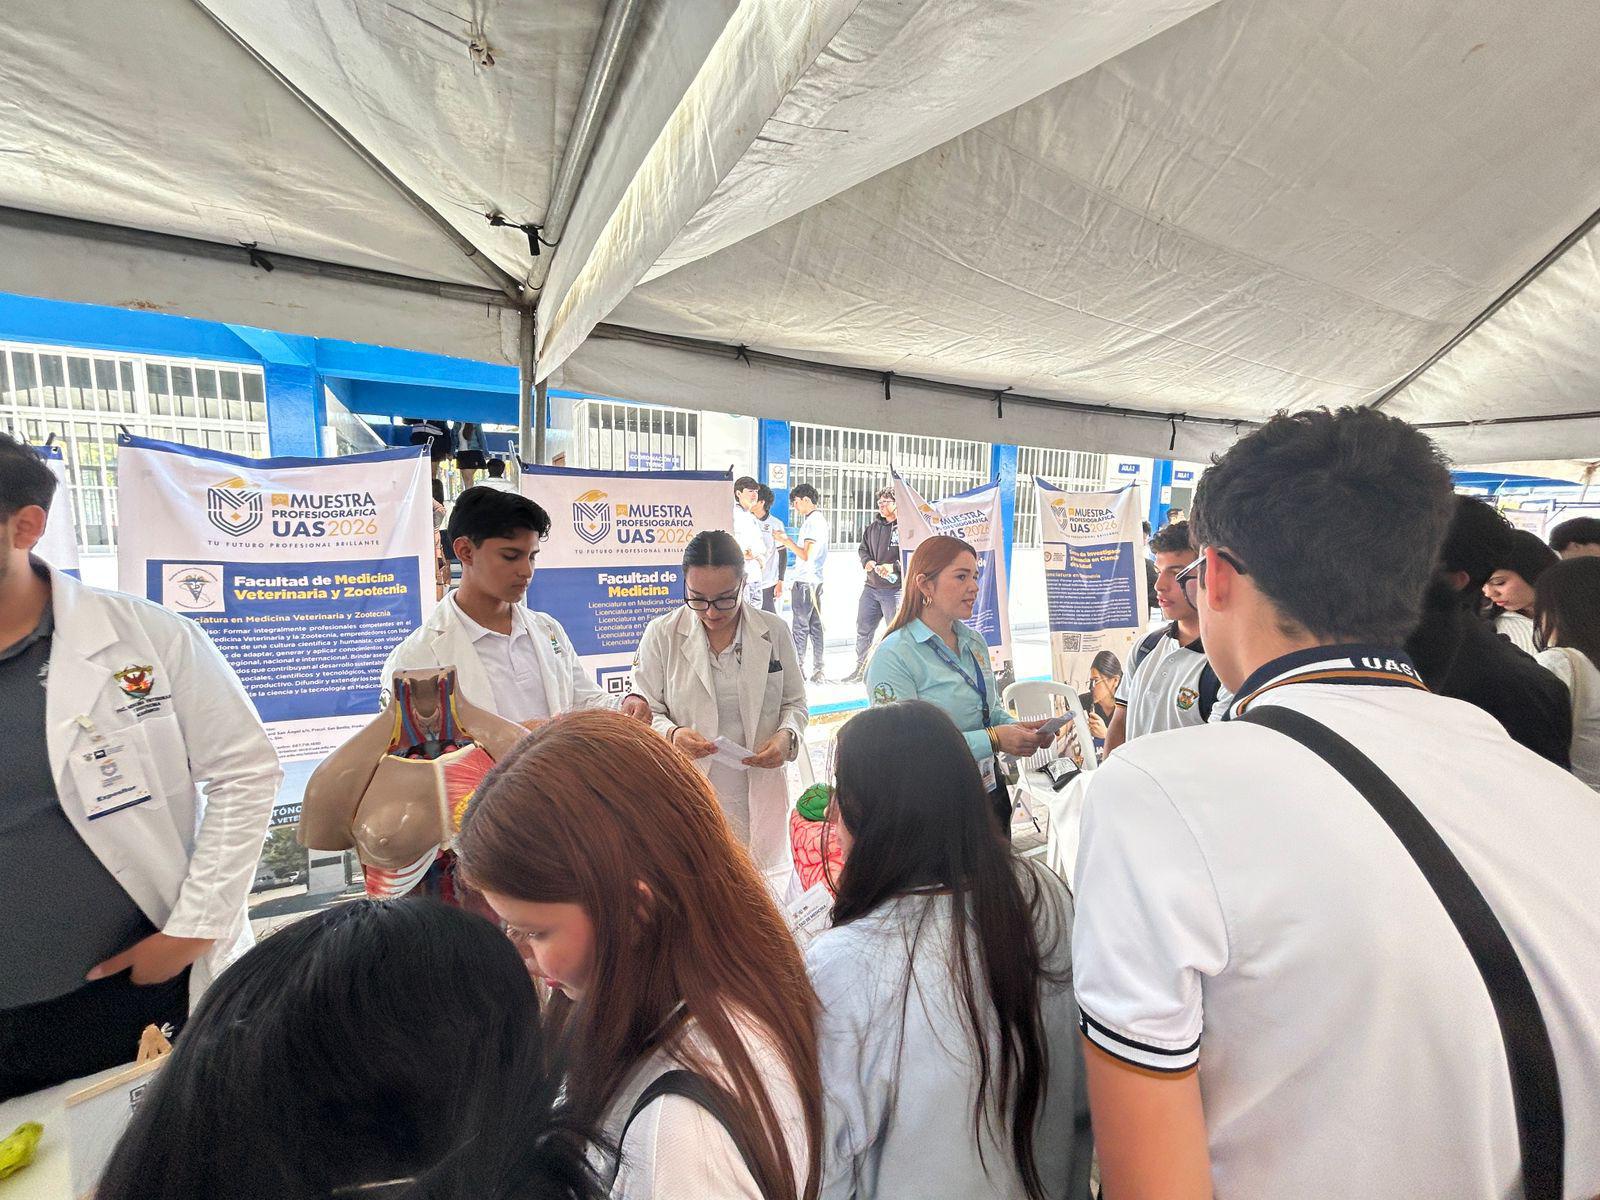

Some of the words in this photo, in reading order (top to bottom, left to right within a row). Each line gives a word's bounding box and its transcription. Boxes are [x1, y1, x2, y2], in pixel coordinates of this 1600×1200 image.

[290, 491, 376, 509] MUESTRA
[271, 508, 377, 519] PROFESIOGRÁFICA
[629, 504, 693, 518] MUESTRA
[940, 509, 986, 526] MUESTRA
[1074, 508, 1113, 518] MUESTRA
[272, 520, 326, 538] UAS
[327, 518, 378, 537] 2026
[616, 518, 694, 527] PROFESIOGRÁFICA
[1070, 523, 1091, 533] UAS
[1090, 519, 1118, 533] 2026
[617, 529, 656, 544] UAS
[234, 575, 309, 587] Facultad
[312, 575, 332, 586] de
[334, 572, 395, 585] Medicina
[598, 571, 658, 584] Facultad
[660, 571, 677, 583] de
[233, 588, 328, 600] Veterinaria
[331, 589, 341, 600] y
[344, 583, 408, 598] Zootecnia
[608, 584, 669, 597] Medicina
[588, 599, 627, 608] Licenciatura
[637, 598, 664, 606] Medicina
[246, 615, 291, 623] Medicina
[293, 612, 345, 621] Veterinaria
[354, 610, 391, 619] Zootecnia
[595, 608, 633, 616] Licenciatura
[254, 626, 307, 634] integralmente
[309, 623, 357, 632] profesionales
[359, 621, 394, 629] competentes
[340, 629, 386, 637] emprendedores
[597, 631, 635, 639] Licenciatura
[601, 639, 639, 647] Licenciatura
[276, 649, 305, 657] generar
[312, 647, 337, 655] aplicar
[339, 645, 383, 653] conocimientos
[263, 657, 294, 665] nacional
